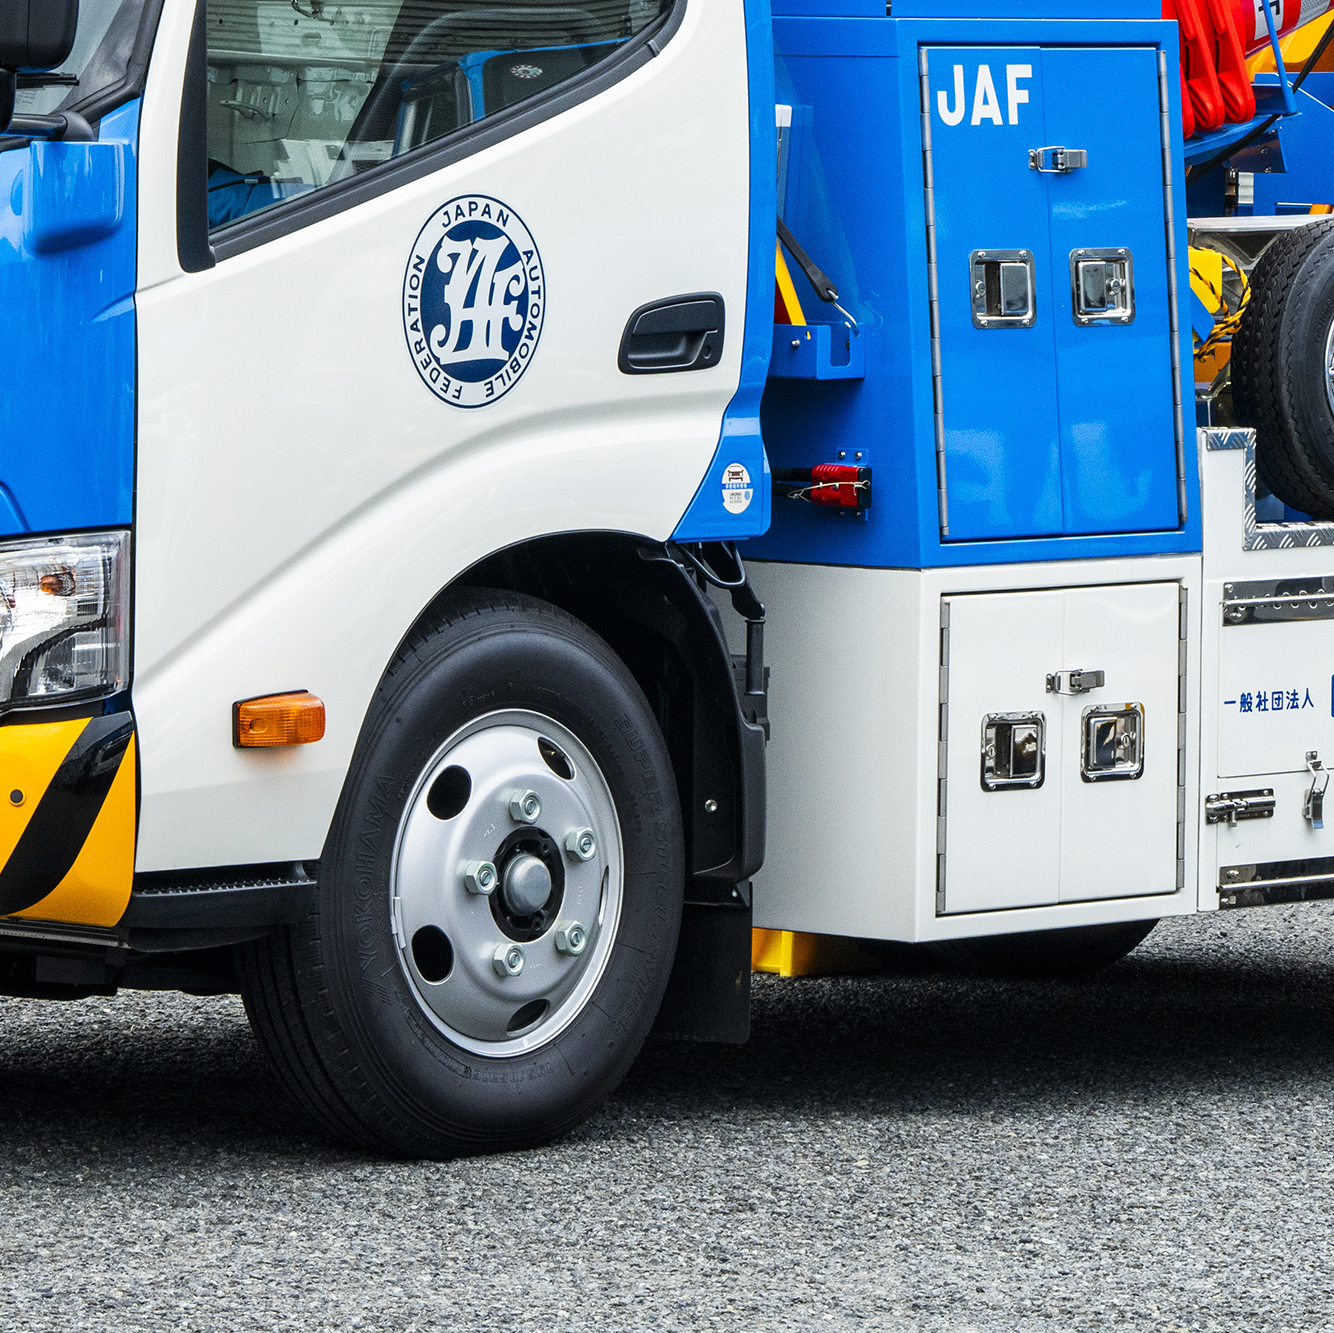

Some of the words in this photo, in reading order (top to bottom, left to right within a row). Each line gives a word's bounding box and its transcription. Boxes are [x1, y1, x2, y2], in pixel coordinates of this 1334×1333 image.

[937, 64, 1033, 126] JAF
[441, 201, 510, 228] JAPAN
[408, 254, 463, 400] FEDERATION
[483, 249, 541, 398] AUTOMOBILE
[1223, 687, 1315, 714] 一般社団法人
[353, 774, 395, 971] YOKOHAMA
